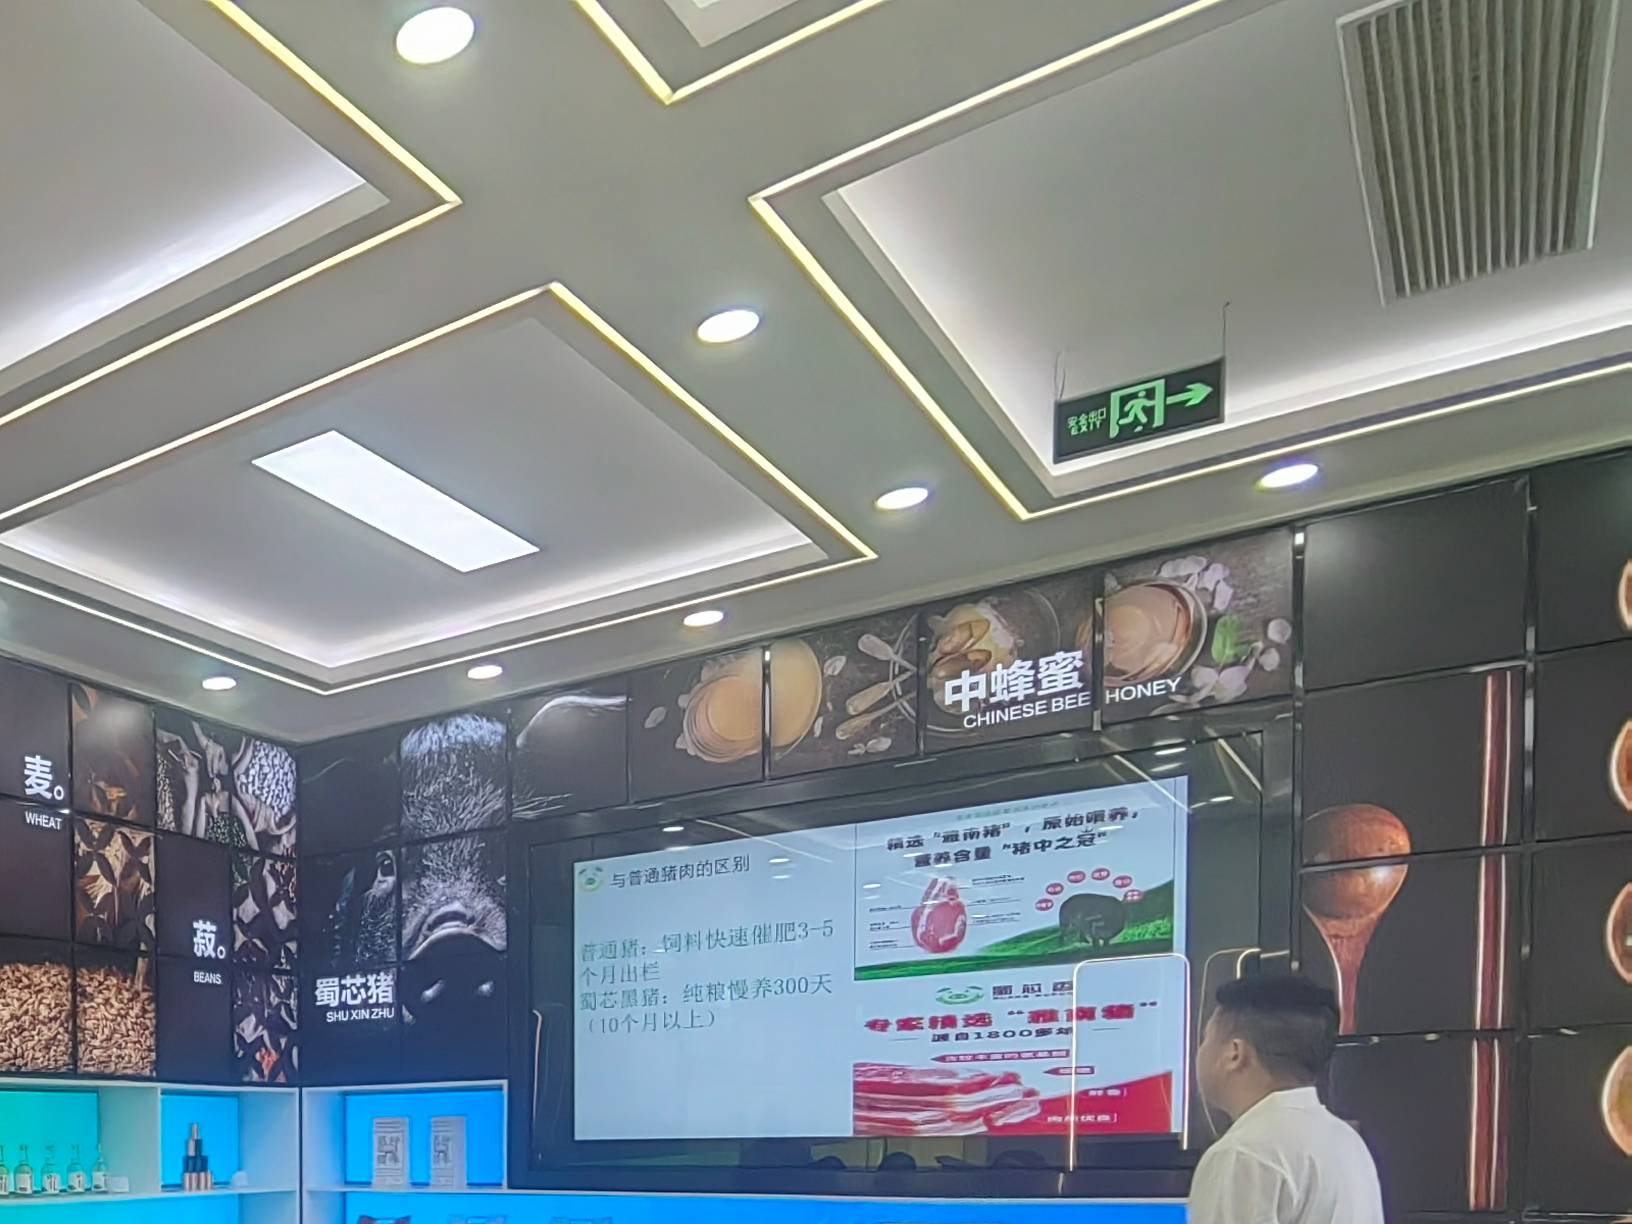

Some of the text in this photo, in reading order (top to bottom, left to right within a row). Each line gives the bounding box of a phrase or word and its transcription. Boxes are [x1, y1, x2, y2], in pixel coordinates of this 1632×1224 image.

[1067, 407, 1107, 429] 安全出口
[943, 650, 1086, 713] 中蜂蜜
[962, 677, 1183, 729] CHINESE BEE HONEY
[24, 811, 63, 831] WHEAT
[609, 854, 751, 889] 与普通猪肉的区别
[193, 970, 223, 985] BEANS
[580, 961, 661, 986] 个月出栏
[314, 970, 395, 1008] 蜀芯猪
[325, 1007, 395, 1023] SHU XIN ZHU
